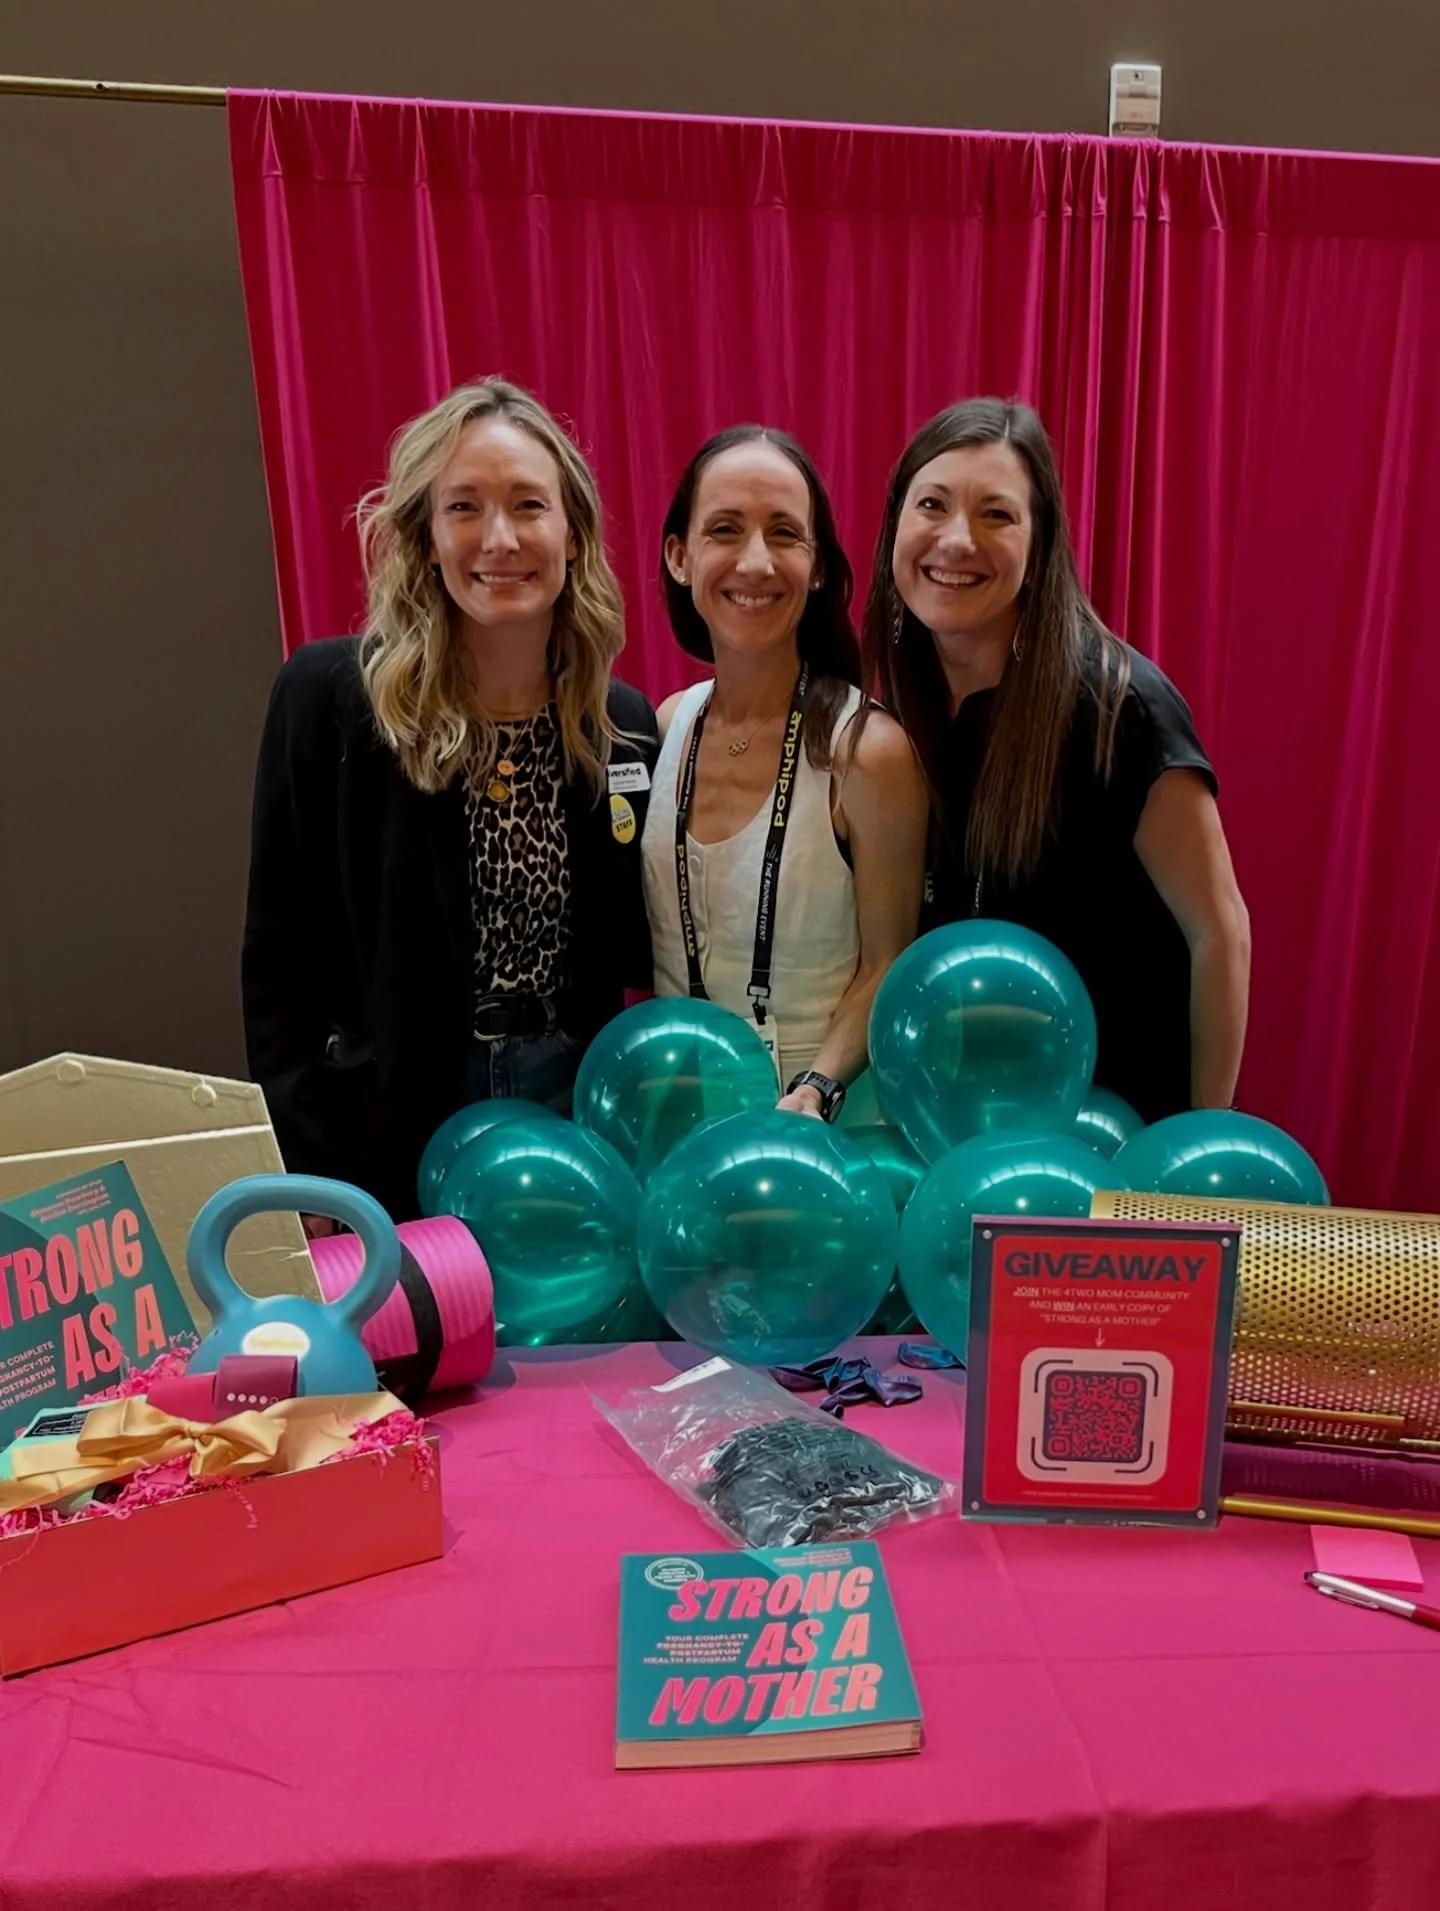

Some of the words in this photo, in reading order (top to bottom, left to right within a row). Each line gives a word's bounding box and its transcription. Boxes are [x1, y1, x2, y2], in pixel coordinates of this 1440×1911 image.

[774, 710, 802, 827] amphipod
[765, 863, 773, 878] THE
[676, 844, 695, 957] amphipod
[761, 879, 771, 914] RUNNING
[759, 915, 768, 941] EVENT
[1004, 1251, 1205, 1281] GIVEAWAY
[1014, 1286, 1039, 1296] JOIN
[1042, 1287, 1062, 1296] THE
[1064, 1288, 1094, 1297] 4TWO
[1096, 1289, 1122, 1298] MOM
[1124, 1289, 1189, 1300] COMMUNITY
[1030, 1300, 1051, 1309] AND
[1053, 1301, 1075, 1311] WIN
[1077, 1302, 1092, 1311] AN
[1093, 1303, 1125, 1312] EARLY
[1126, 1303, 1155, 1313] COPY
[1157, 1304, 1171, 1313] OF
[1088, 1315, 1101, 1324] AS
[1104, 1316, 1111, 1325] A
[63, 1302, 124, 1389] AS
[134, 1283, 166, 1358] A
[7, 1340, 55, 1366] COMPLETE
[15, 1378, 57, 1403] PROGRAM
[668, 1566, 874, 1621] STRONG
[695, 1633, 749, 1641] COMPLETE
[746, 1619, 824, 1669] AS
[831, 1613, 870, 1661] A
[670, 1648, 741, 1656] POSTPARTUM
[685, 1655, 737, 1664] PROGRAM
[648, 1663, 883, 1726] MOTHER
